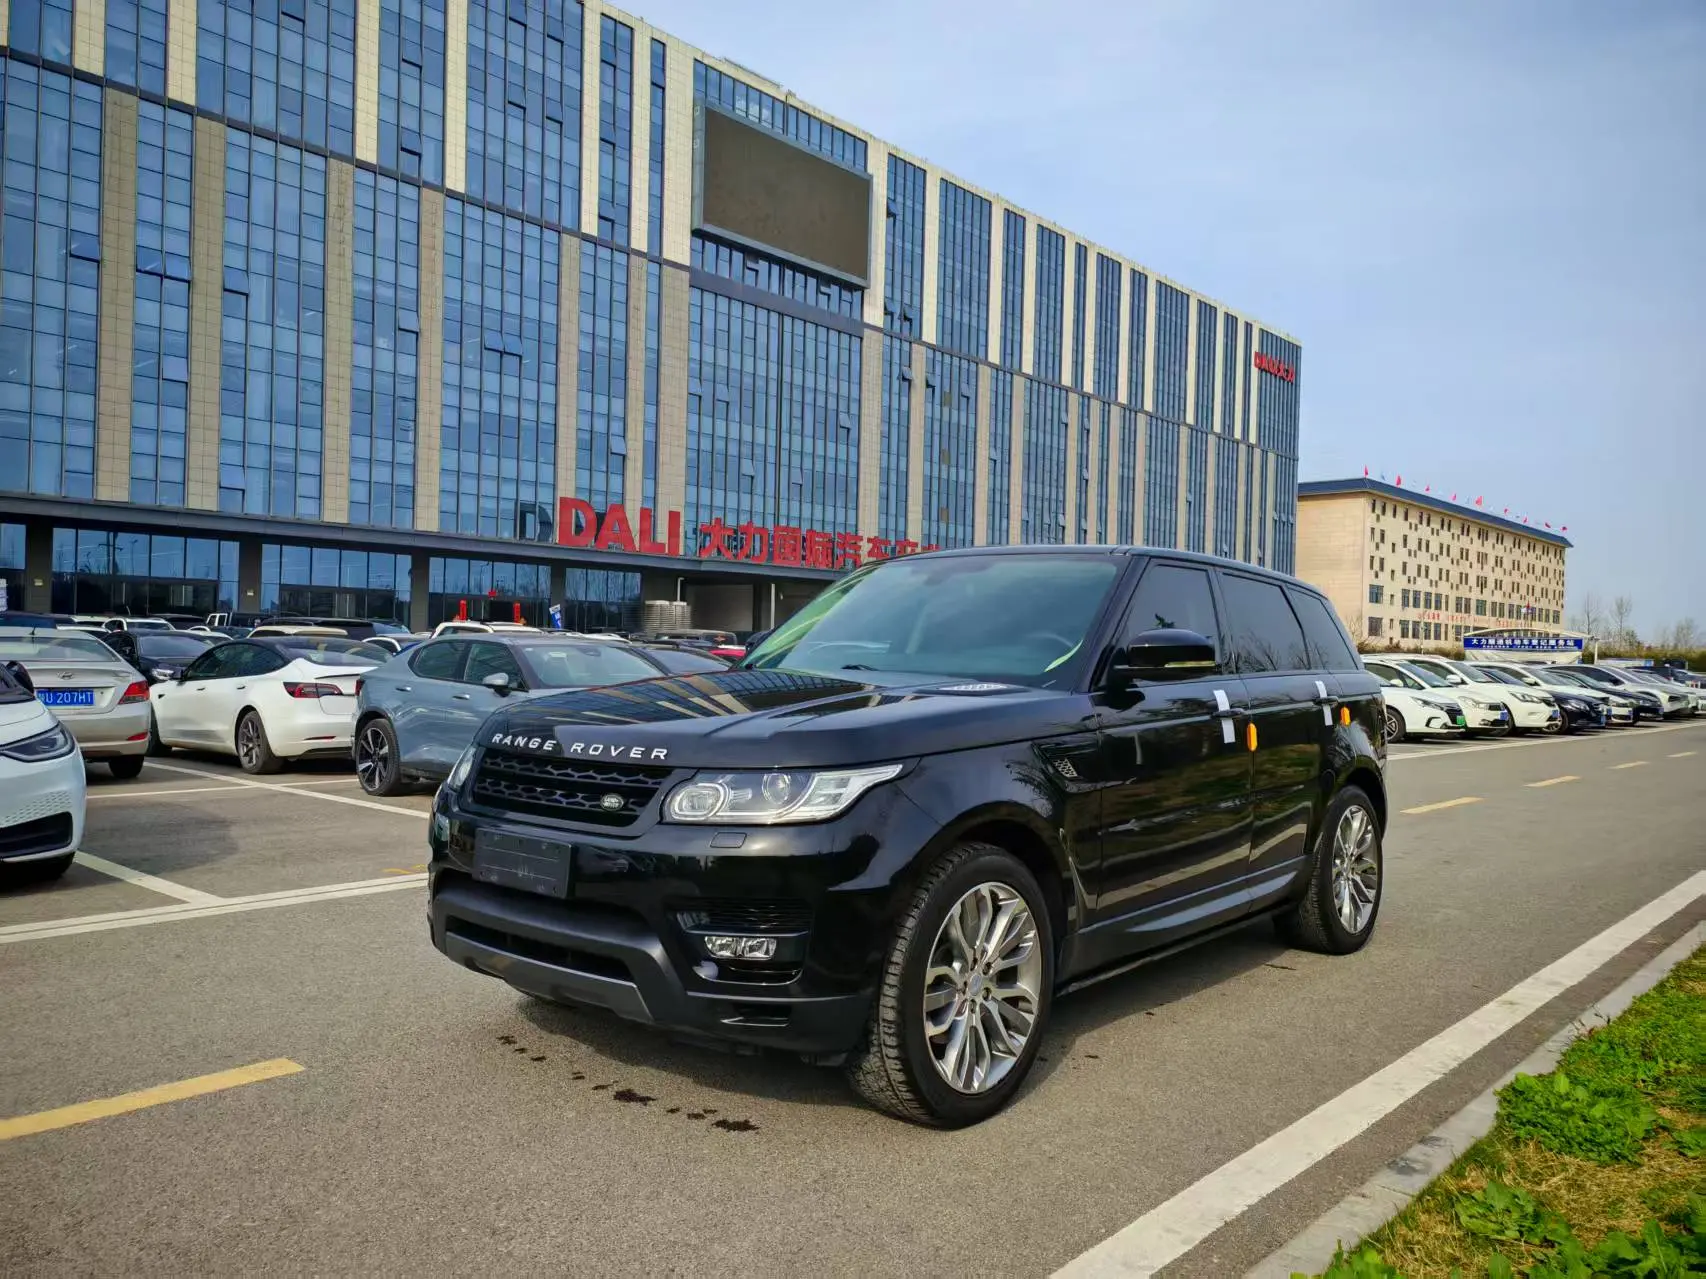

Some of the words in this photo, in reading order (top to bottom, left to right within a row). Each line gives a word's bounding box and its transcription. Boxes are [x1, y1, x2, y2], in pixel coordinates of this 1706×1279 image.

[558, 496, 681, 557] DALI
[56, 691, 92, 704] 207HT
[491, 733, 556, 751] RANGE
[570, 742, 668, 760] ROVER
